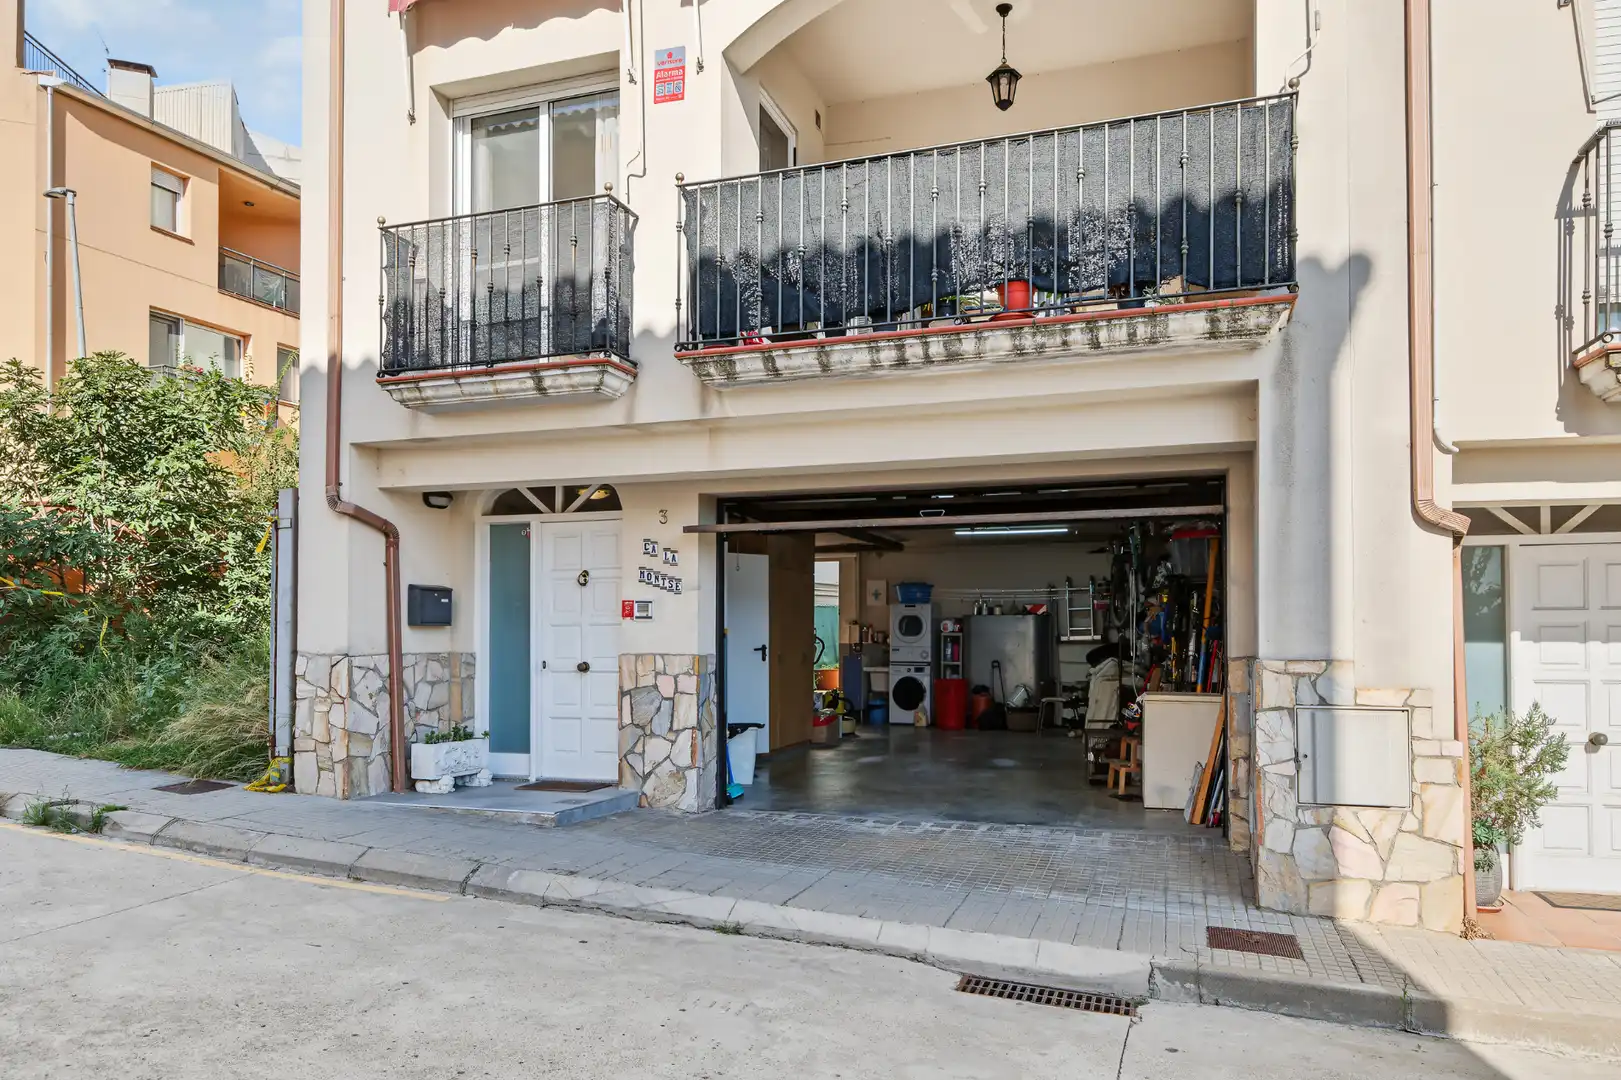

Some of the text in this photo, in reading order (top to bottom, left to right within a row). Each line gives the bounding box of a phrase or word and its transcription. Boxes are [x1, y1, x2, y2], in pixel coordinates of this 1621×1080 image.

[656, 69, 683, 79] Alarma
[658, 509, 668, 524] 3
[643, 541, 678, 563] CA LA
[639, 570, 681, 591] MONTSE
